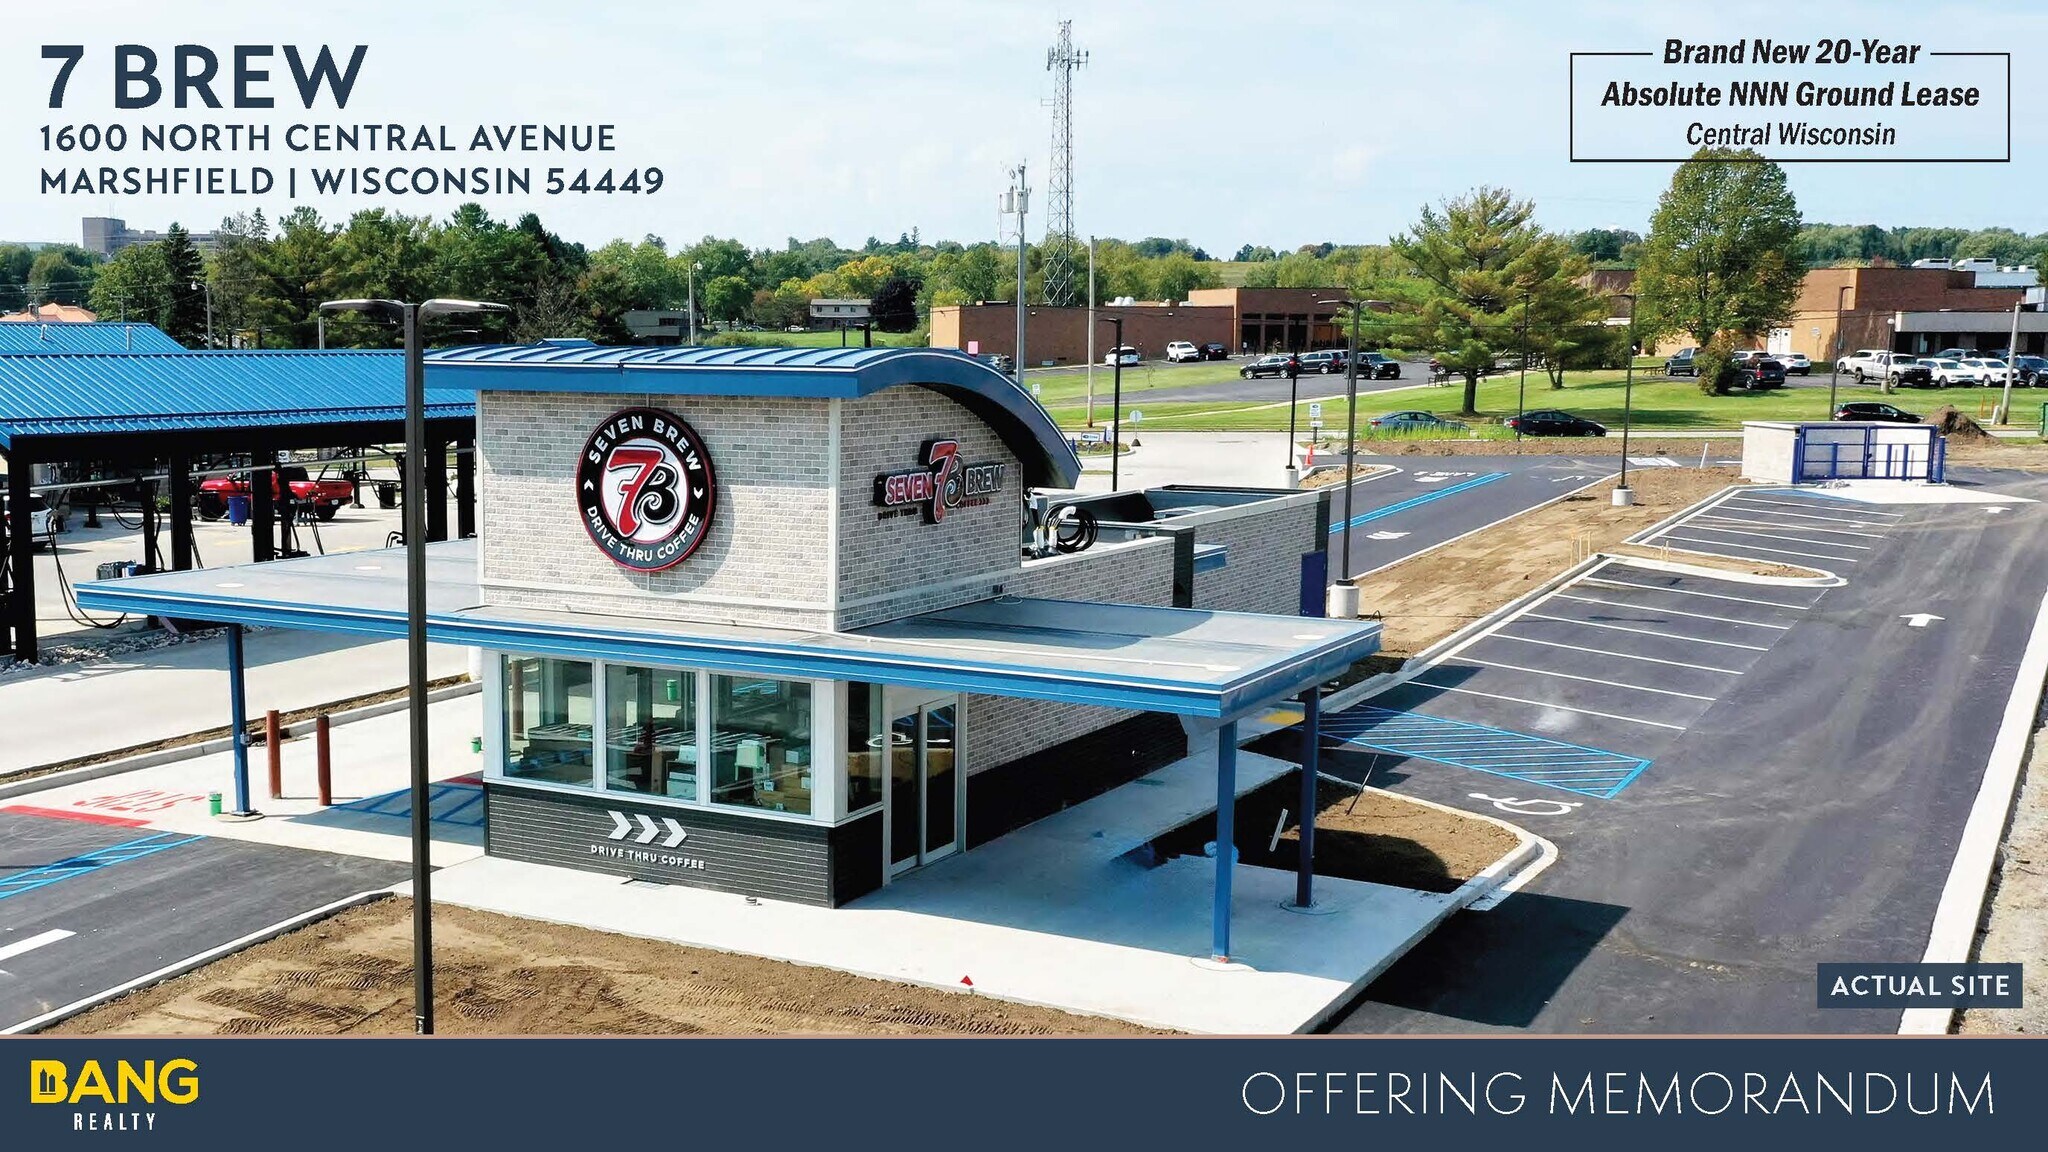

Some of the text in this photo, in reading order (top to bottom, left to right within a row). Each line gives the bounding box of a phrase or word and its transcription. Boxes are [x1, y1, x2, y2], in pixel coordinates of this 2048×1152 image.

[589, 415, 702, 471] SEVEN BREW
[885, 472, 934, 505] SEVEN
[965, 464, 1005, 496] BREW
[587, 506, 699, 562] DRIVE THRU COFFEE
[590, 844, 705, 870] DRIVE THRU COFFEE
